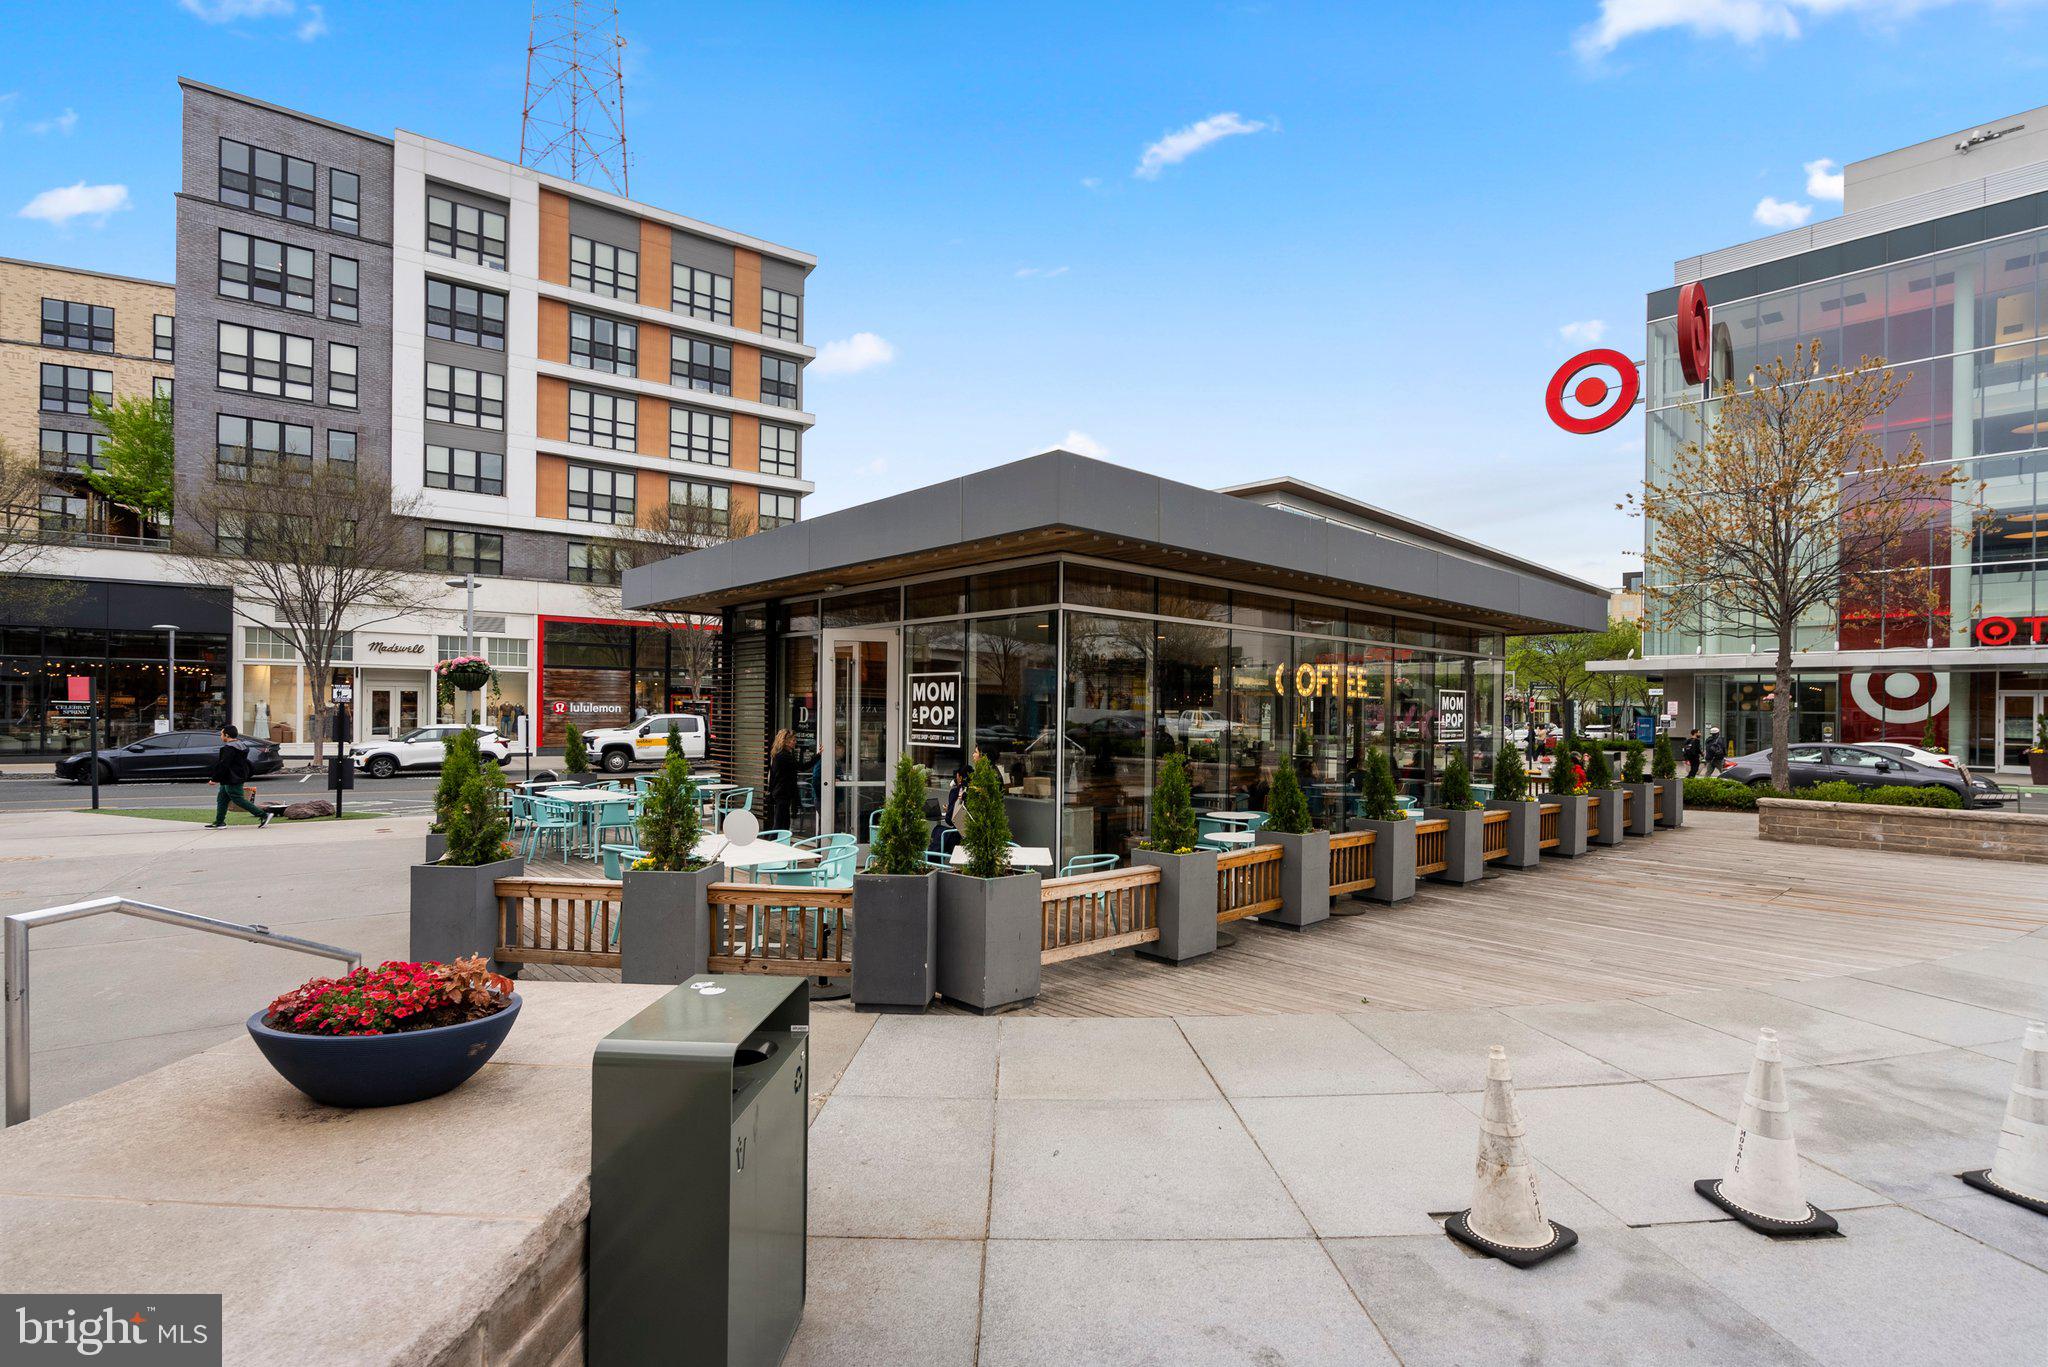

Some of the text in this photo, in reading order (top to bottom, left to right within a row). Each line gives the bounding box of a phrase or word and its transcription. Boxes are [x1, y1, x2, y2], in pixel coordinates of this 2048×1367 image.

[368, 642, 425, 654] Madewell
[913, 682, 955, 702] MOM
[570, 702, 622, 713] lululemon
[1441, 696, 1463, 711] MOM
[919, 705, 955, 726] POP
[1445, 712, 1464, 728] POP
[1734, 1129, 1746, 1173] MOSAIC
